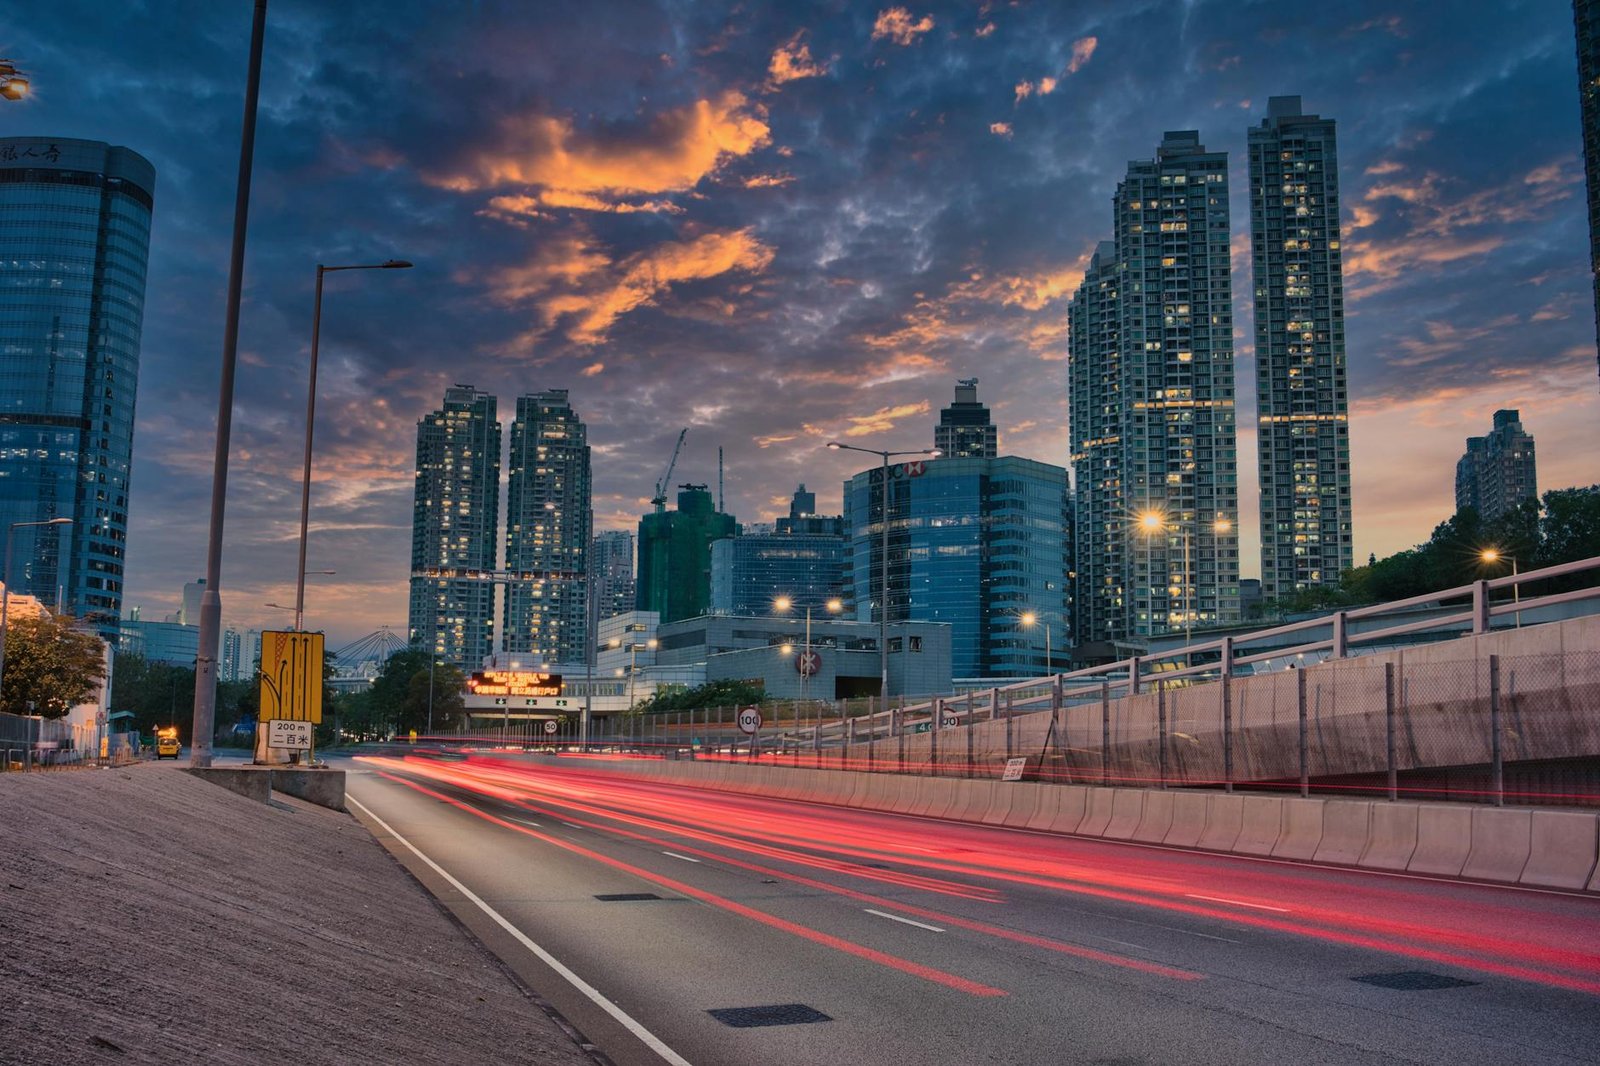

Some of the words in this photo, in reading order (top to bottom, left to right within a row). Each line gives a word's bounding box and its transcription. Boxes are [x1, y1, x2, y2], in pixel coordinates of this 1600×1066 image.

[277, 723, 295, 731] 200
[273, 734, 309, 745] 二百米
